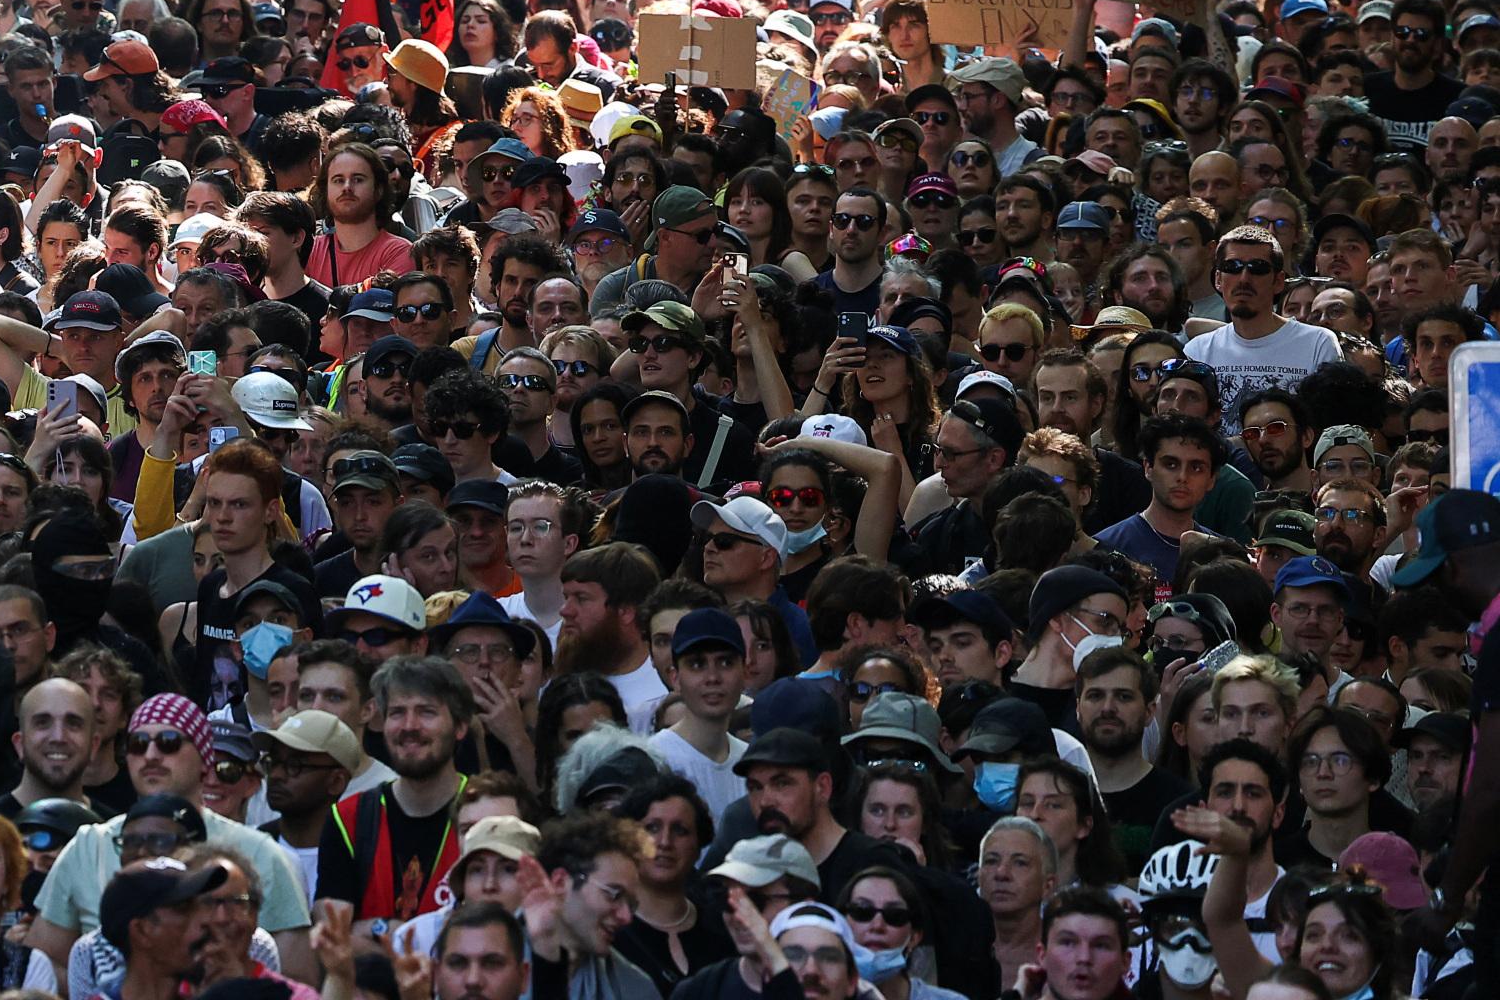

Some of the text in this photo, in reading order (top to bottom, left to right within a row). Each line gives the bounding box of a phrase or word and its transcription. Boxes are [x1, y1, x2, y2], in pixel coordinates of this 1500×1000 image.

[1213, 364, 1309, 376] ARDE LES HOMMES TOMBER
[274, 400, 296, 409] Supreme
[812, 430, 831, 438] HOPE
